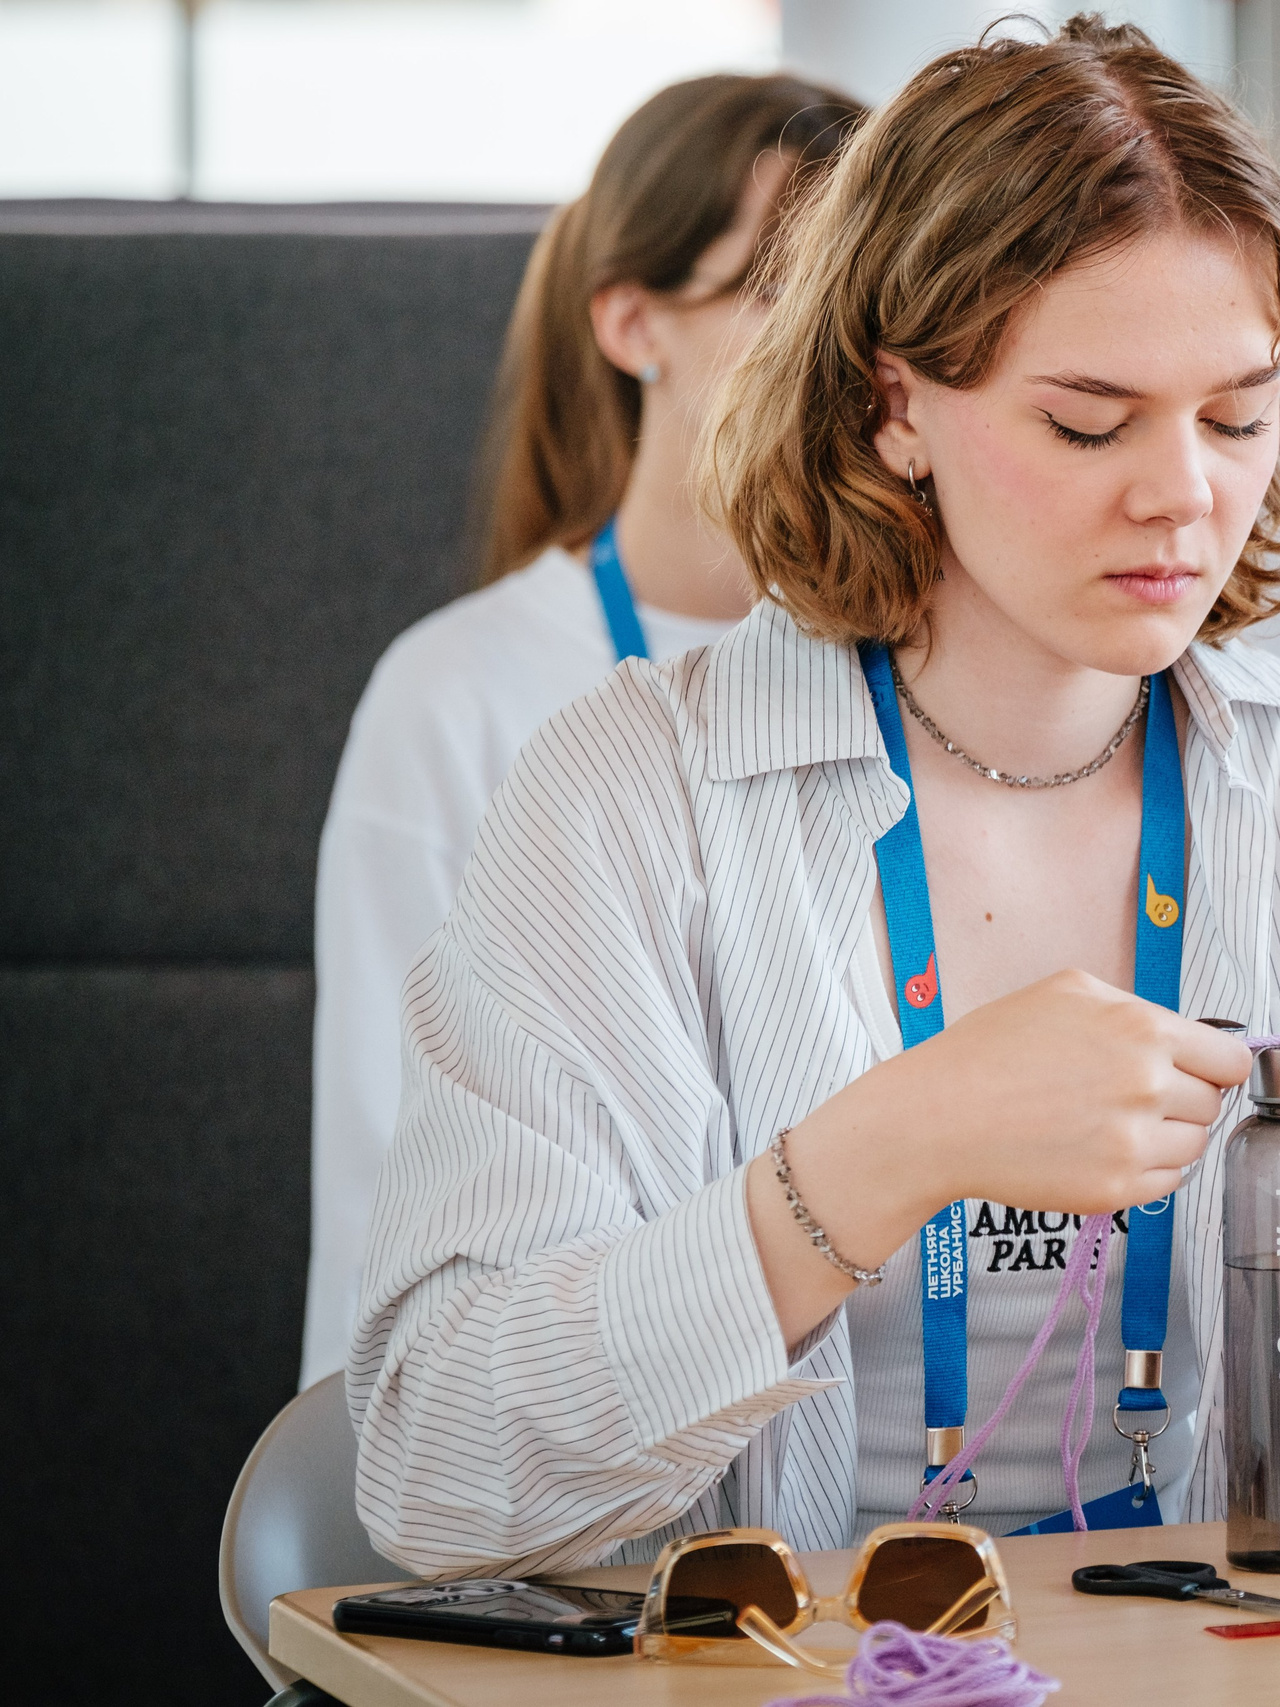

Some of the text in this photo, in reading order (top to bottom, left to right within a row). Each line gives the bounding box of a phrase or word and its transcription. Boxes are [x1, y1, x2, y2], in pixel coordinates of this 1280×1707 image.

[969, 1202, 1128, 1237] AMO
[926, 1223, 939, 1300] ЛЕТНЯЯ
[939, 1226, 951, 1298] ШКОЛА
[987, 1238, 1101, 1272] PARS
